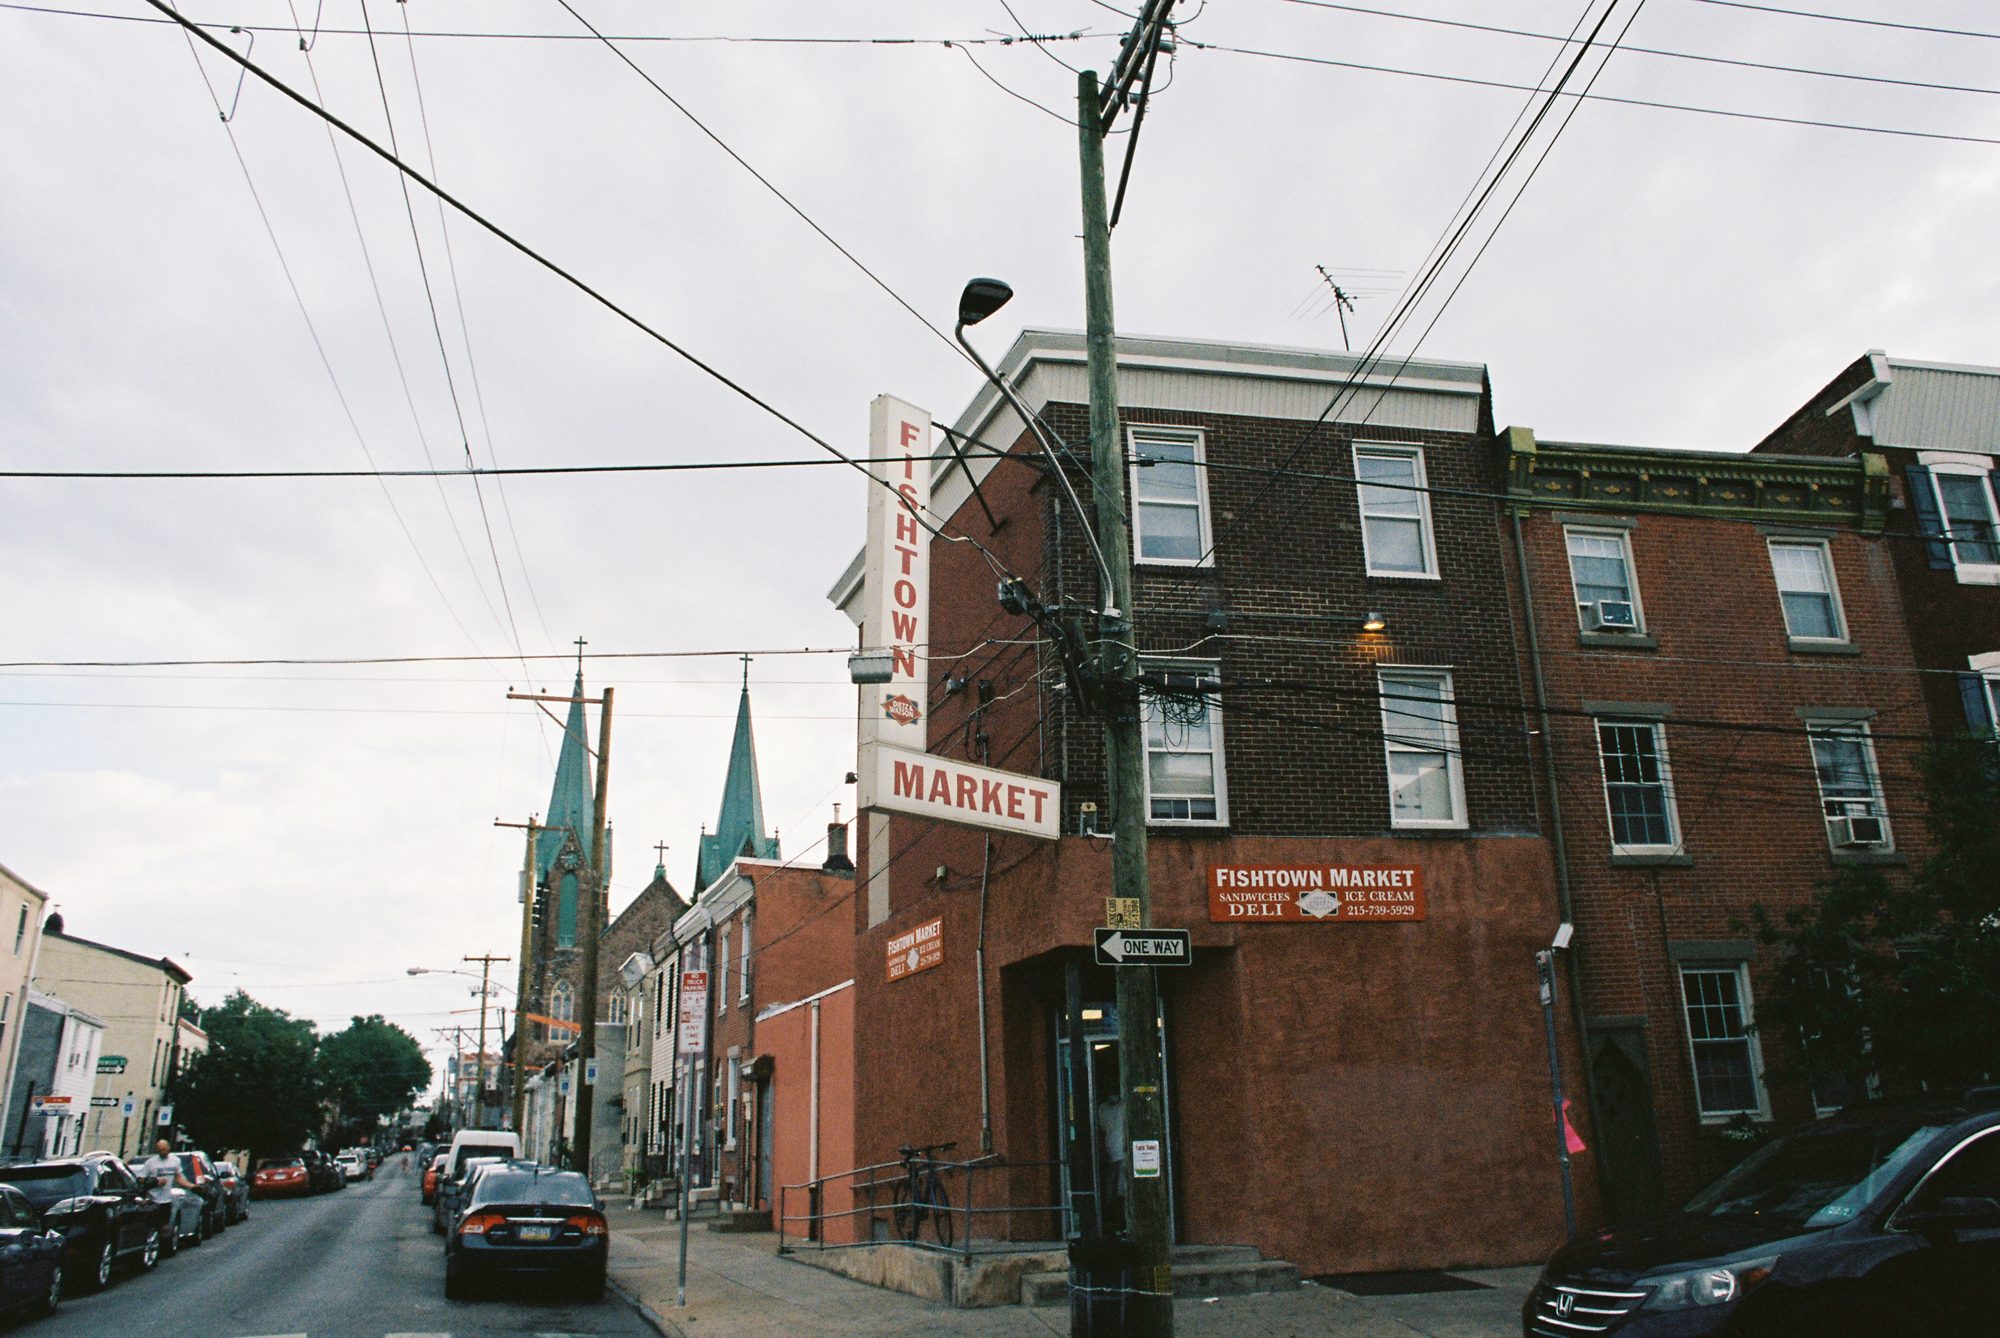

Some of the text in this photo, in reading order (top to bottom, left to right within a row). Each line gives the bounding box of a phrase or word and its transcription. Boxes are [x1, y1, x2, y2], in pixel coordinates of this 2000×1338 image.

[892, 420, 920, 678] FISHTOWN
[889, 705, 915, 718] WATSON
[893, 760, 1048, 824] MARKET
[1216, 868, 1414, 887] FISHTOWN MARKET
[1219, 890, 1415, 902] SANDWICHES ICE CREAM
[1228, 903, 1415, 916] DELI 215-739-5929
[915, 920, 941, 944] MARKET
[1123, 940, 1179, 954] ONE WAY
